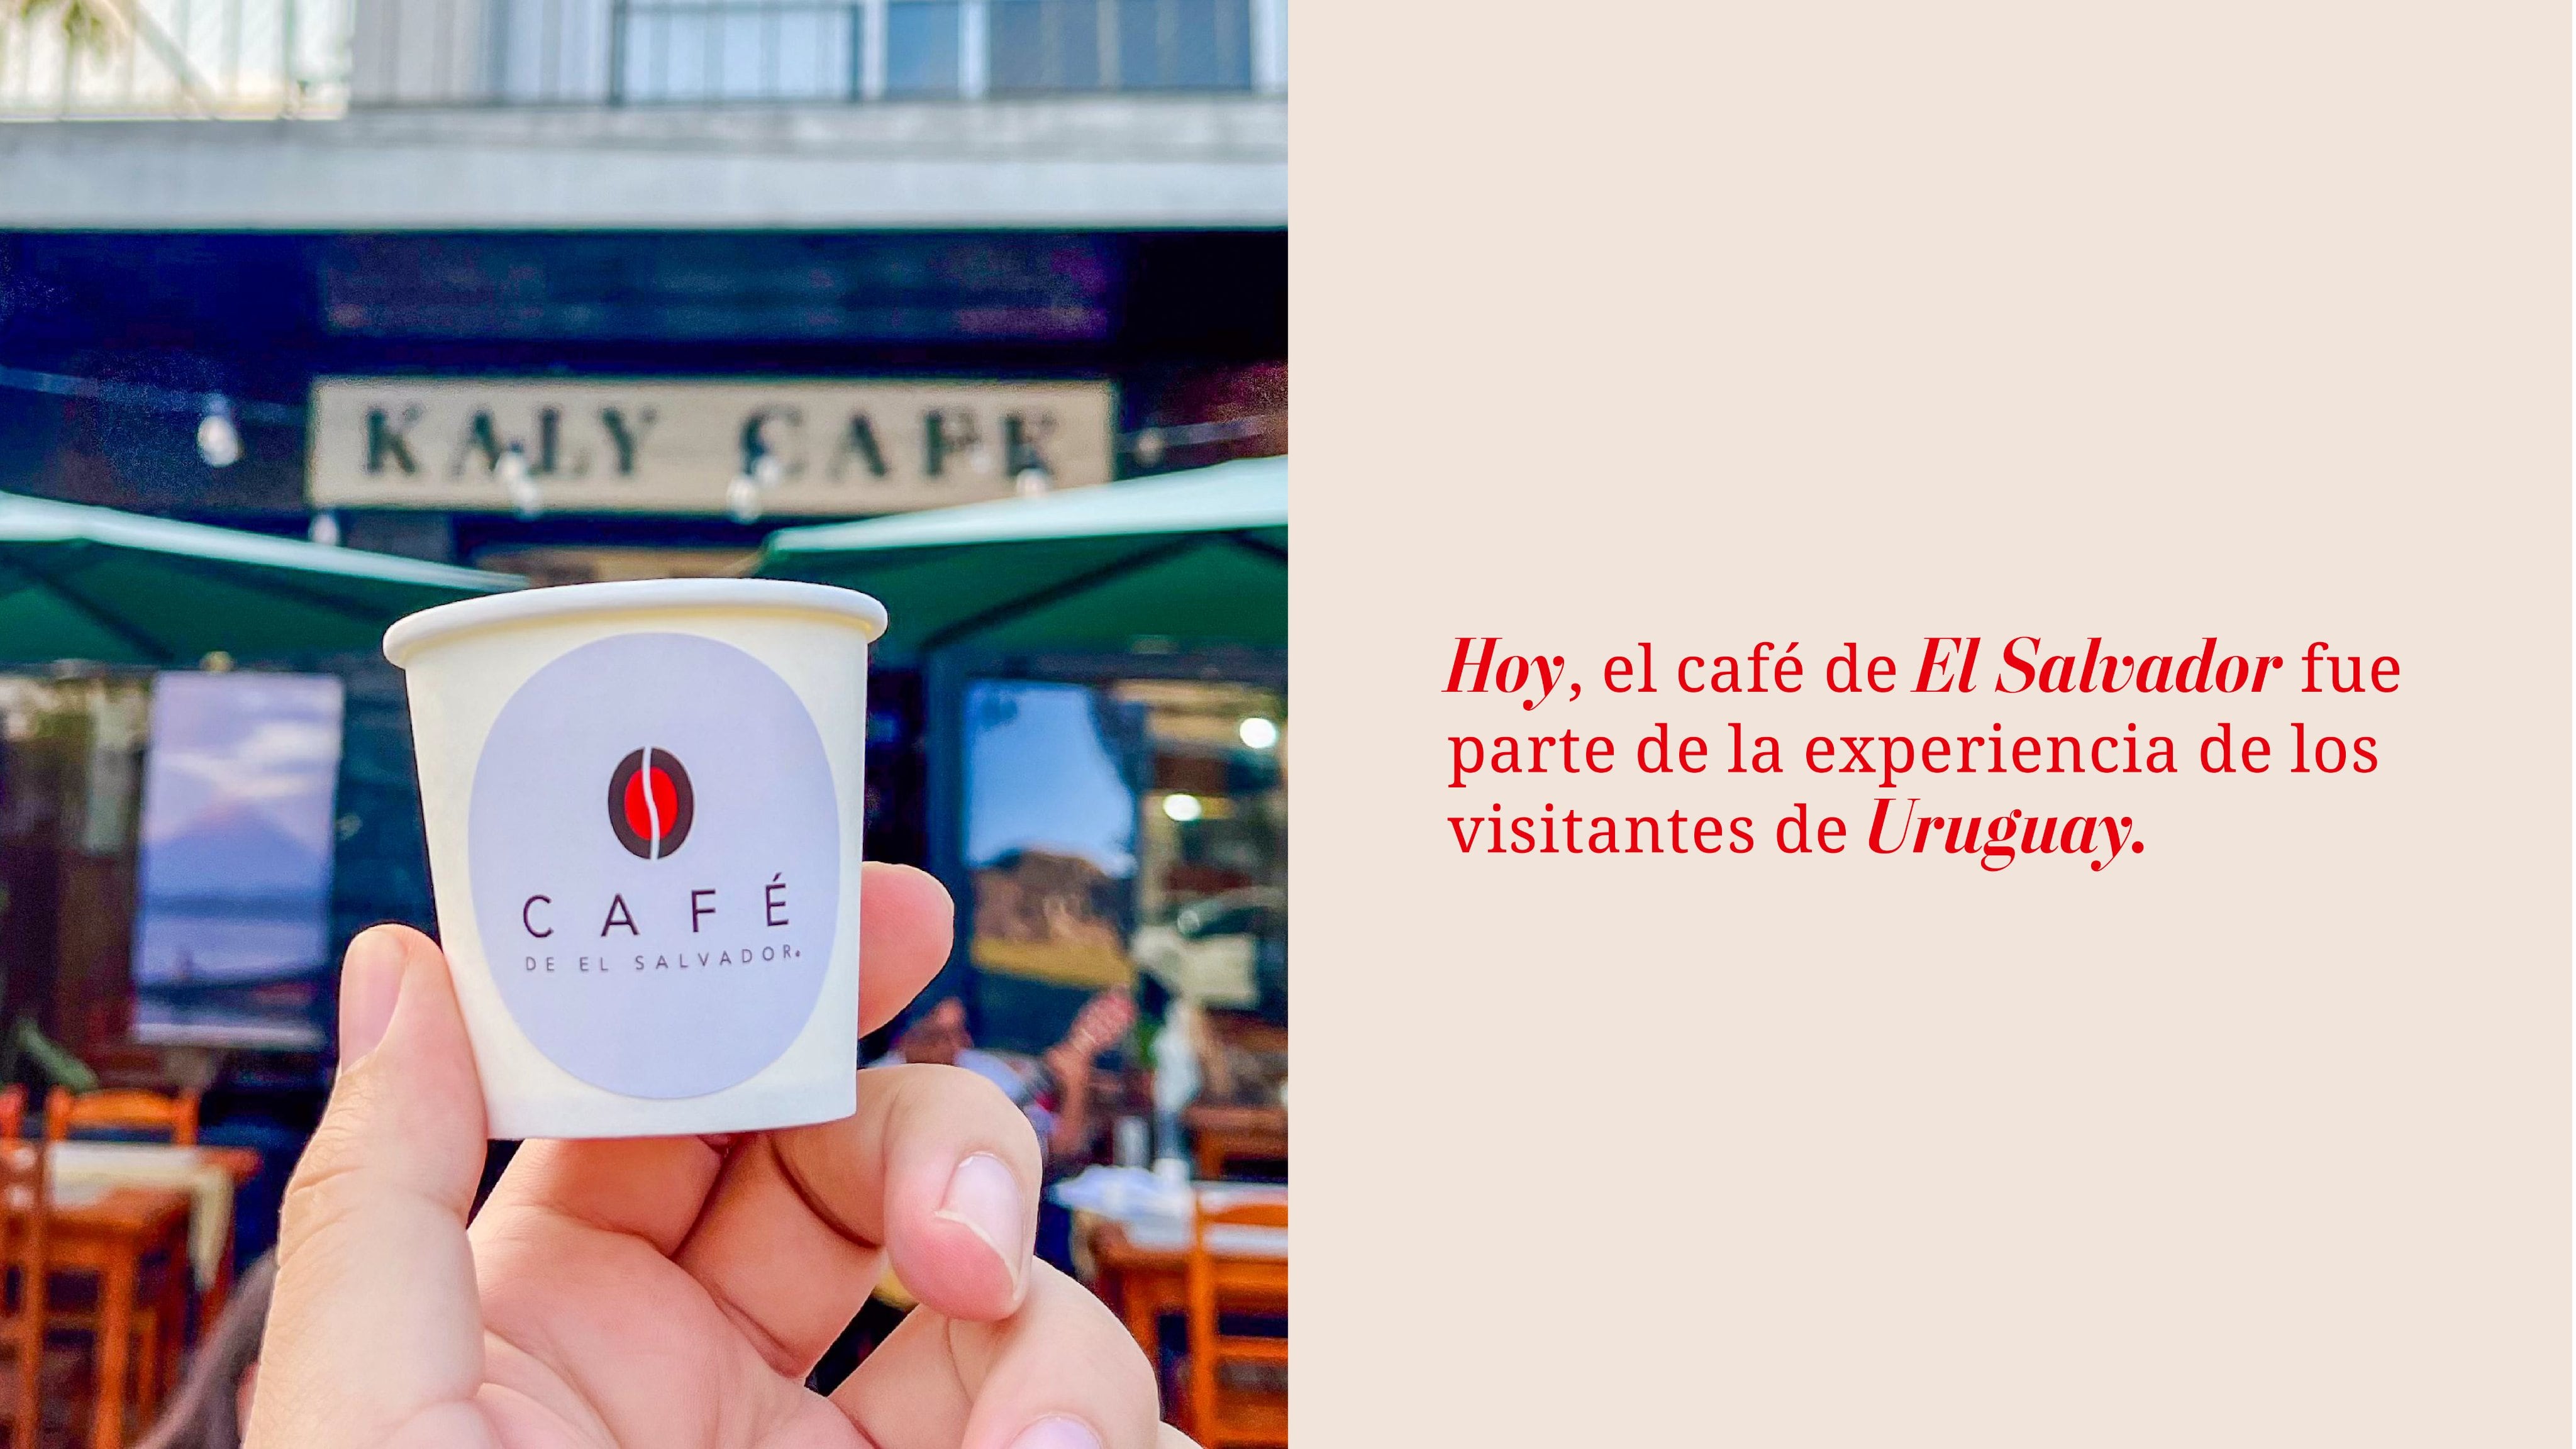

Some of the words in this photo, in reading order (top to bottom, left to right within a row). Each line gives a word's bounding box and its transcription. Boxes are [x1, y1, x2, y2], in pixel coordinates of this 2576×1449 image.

[364, 404, 660, 479] KALY
[522, 872, 790, 939] CAFÉ
[526, 956, 556, 972] DE
[579, 956, 609, 972] EL
